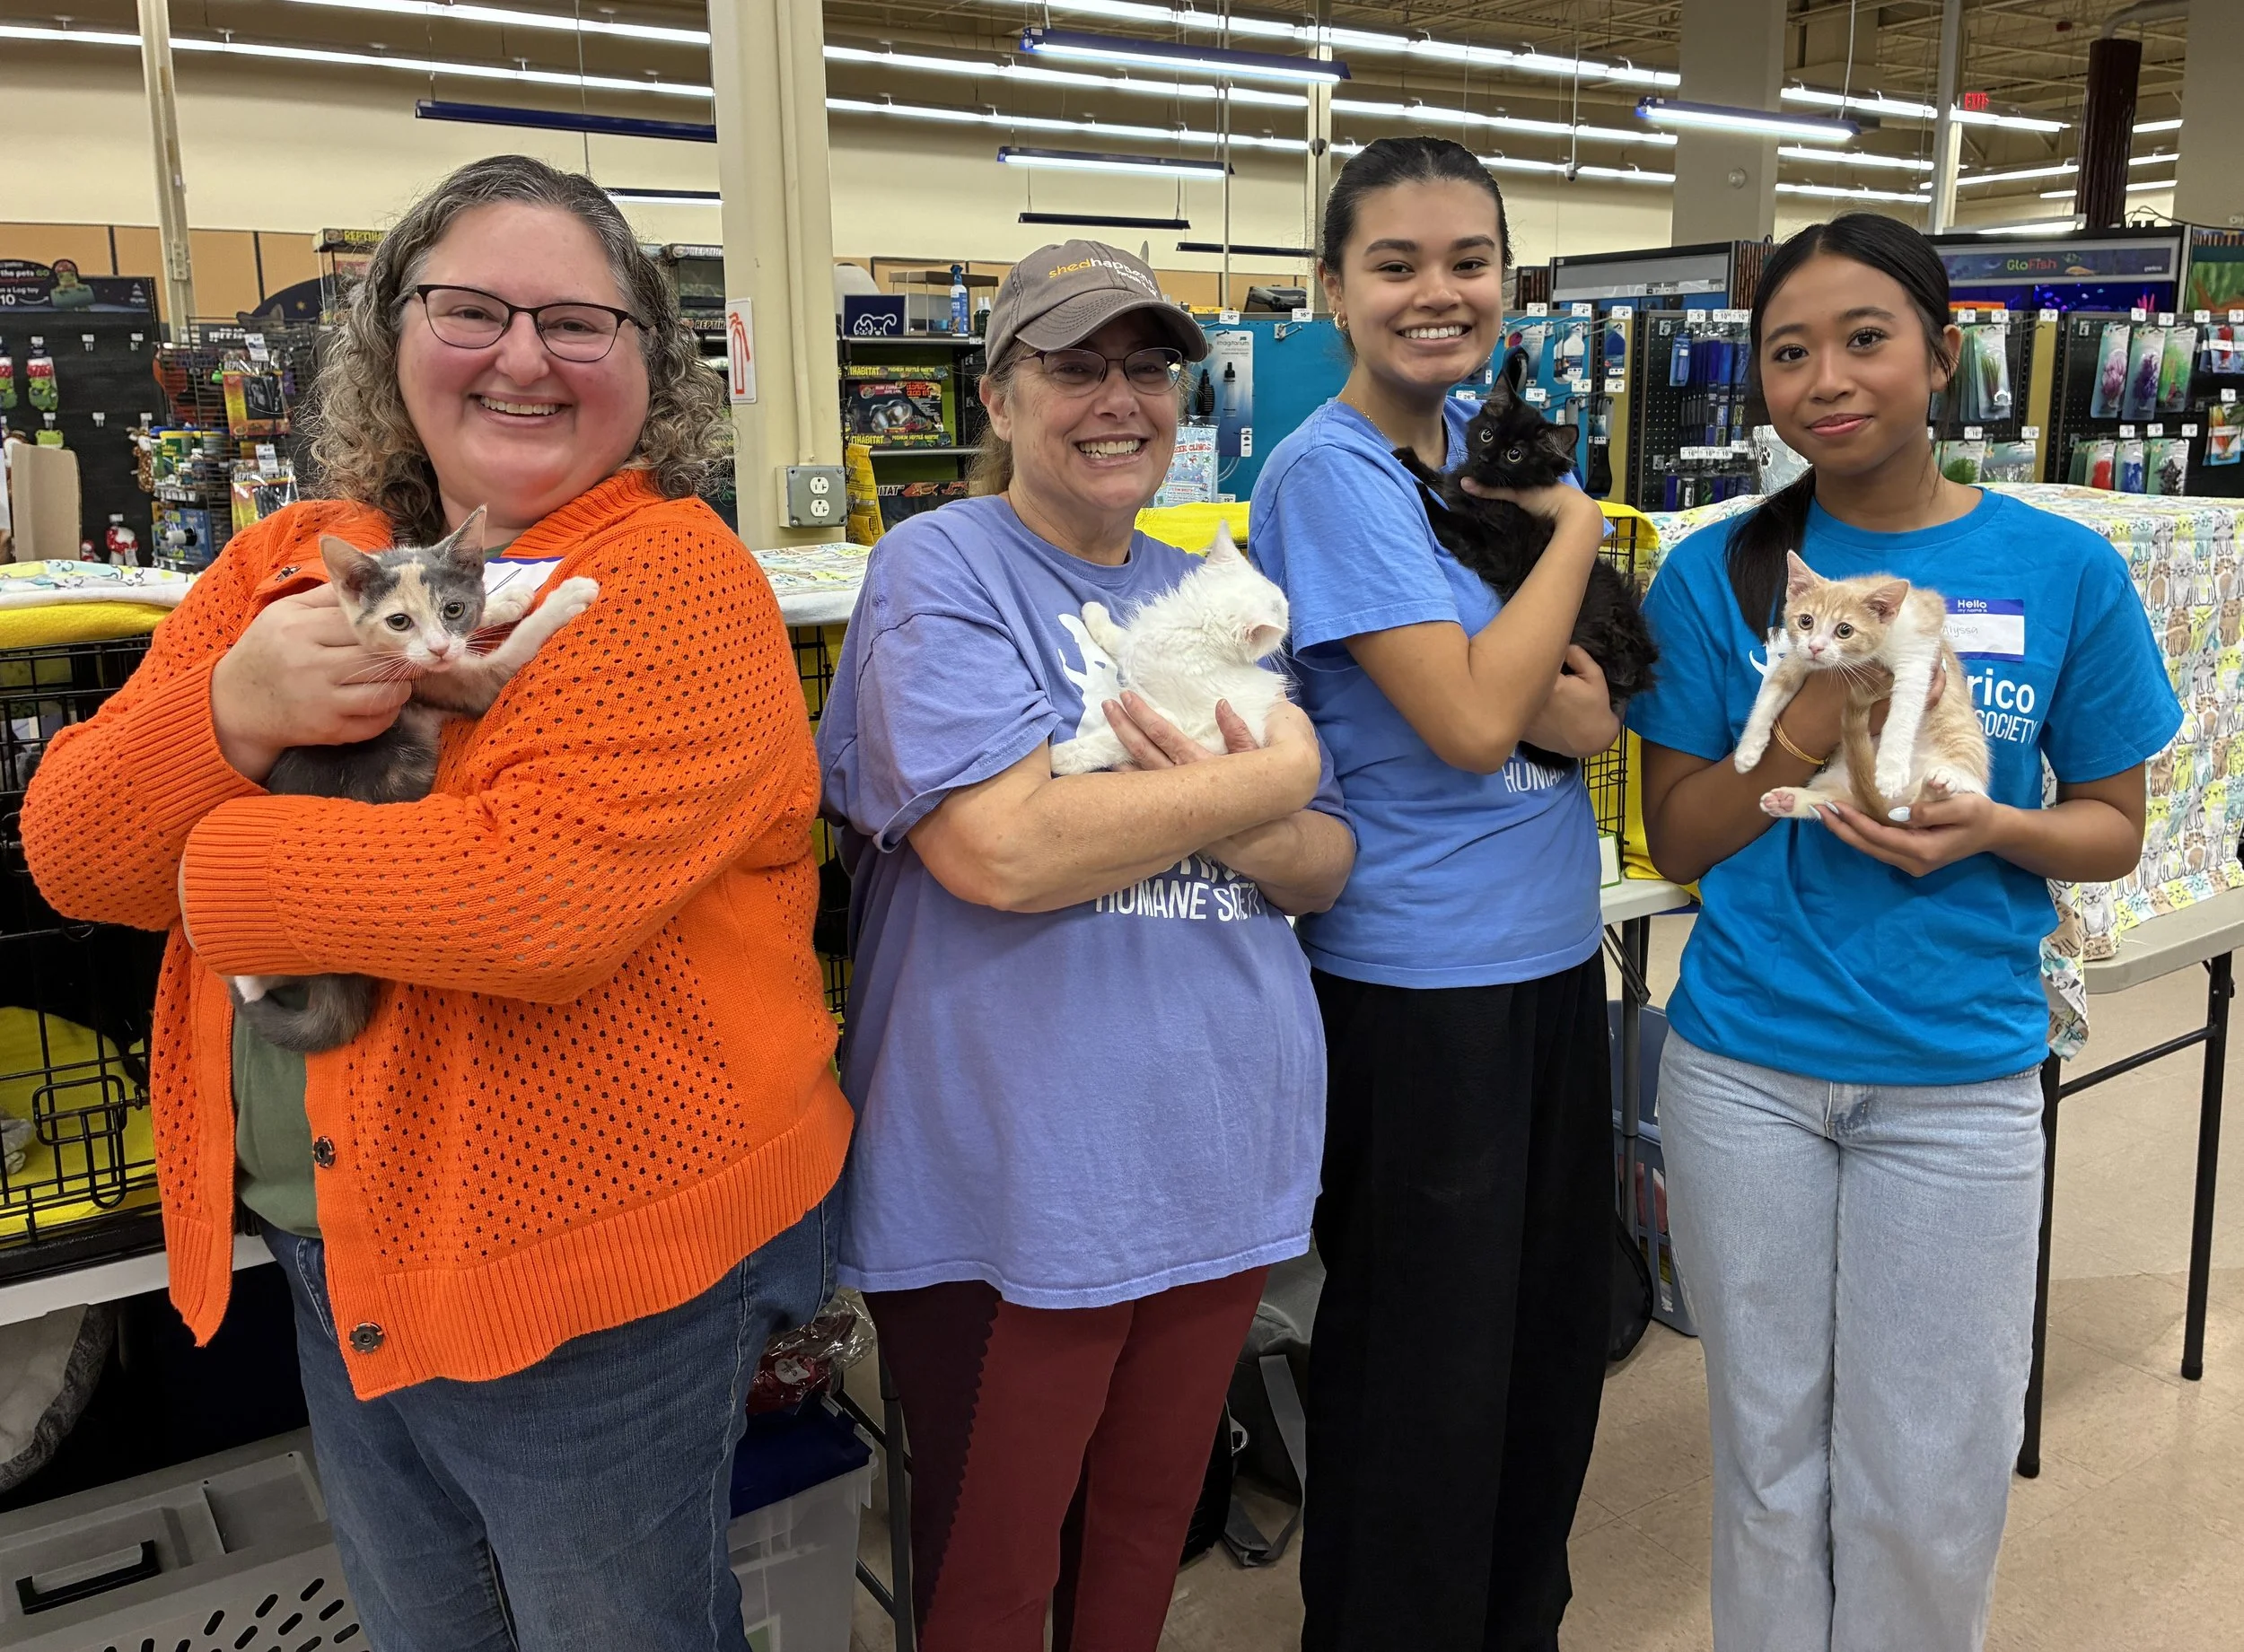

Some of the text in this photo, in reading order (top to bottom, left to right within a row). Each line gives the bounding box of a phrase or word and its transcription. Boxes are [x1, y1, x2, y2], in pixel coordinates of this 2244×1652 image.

[1965, 92, 1986, 110] EXIT
[2007, 258, 2057, 271] GloFish
[1958, 599, 1987, 609] Hello
[1942, 625, 1978, 638] Alyssa
[1967, 668, 2035, 714] rico
[1975, 709, 2038, 744] SOCIETY
